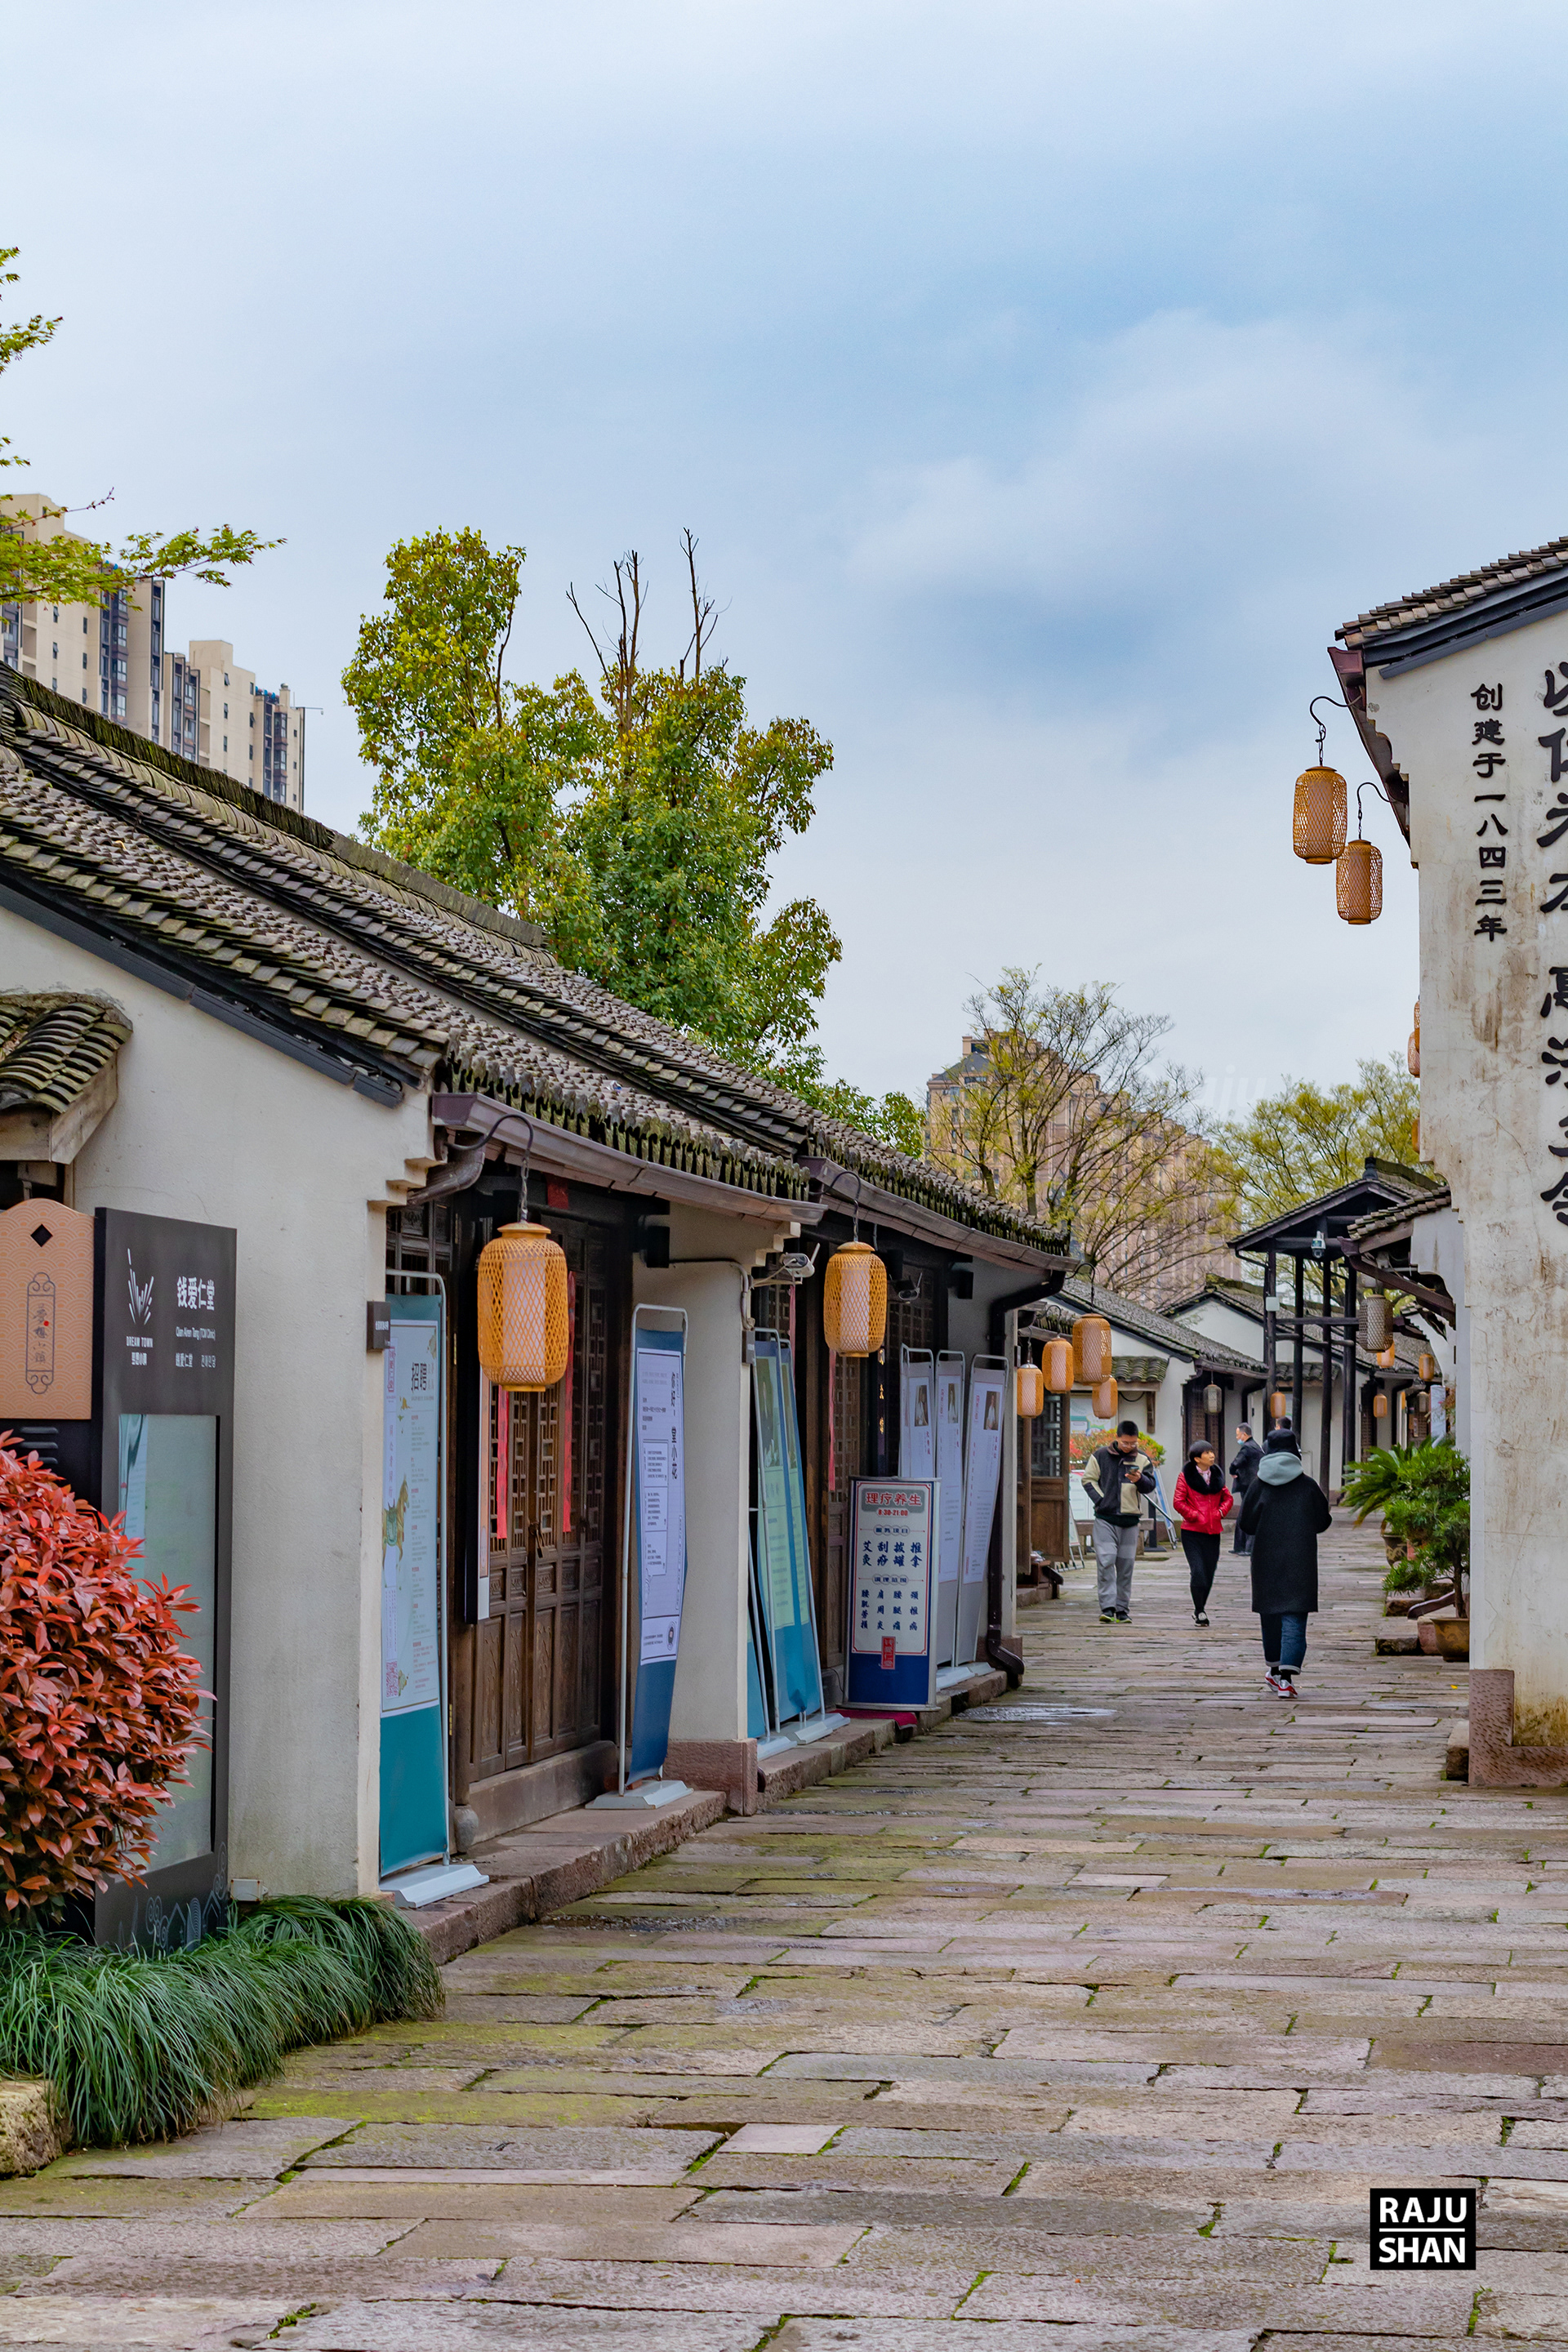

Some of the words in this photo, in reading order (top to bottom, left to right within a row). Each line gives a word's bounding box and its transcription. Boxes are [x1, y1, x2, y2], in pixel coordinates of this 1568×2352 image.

[1470, 682, 1508, 942] 创建于一八四三年
[176, 1276, 215, 1312] 钱爱仁堂
[411, 1362, 428, 1392] 招聘
[866, 1492, 922, 1507] 理疗养生
[878, 1508, 908, 1517] 8:30-21:00
